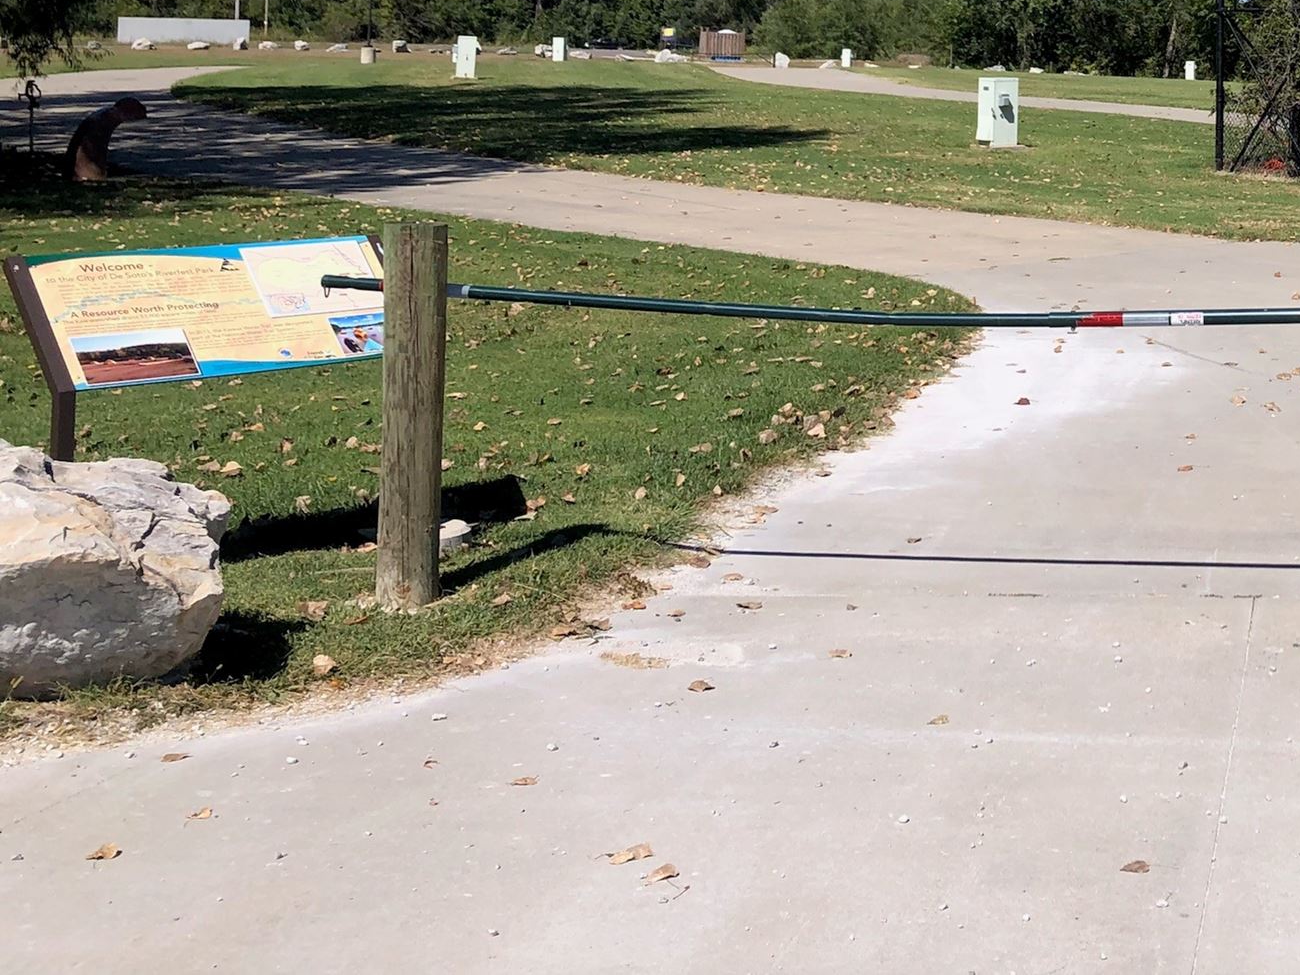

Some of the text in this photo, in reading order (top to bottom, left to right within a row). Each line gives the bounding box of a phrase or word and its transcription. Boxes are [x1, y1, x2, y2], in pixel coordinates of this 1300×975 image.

[79, 263, 144, 273] Welcome
[76, 274, 95, 283] City
[98, 272, 108, 280] of
[81, 310, 129, 318] Resource
[131, 305, 164, 314] Worth
[166, 302, 220, 312] Protecting
